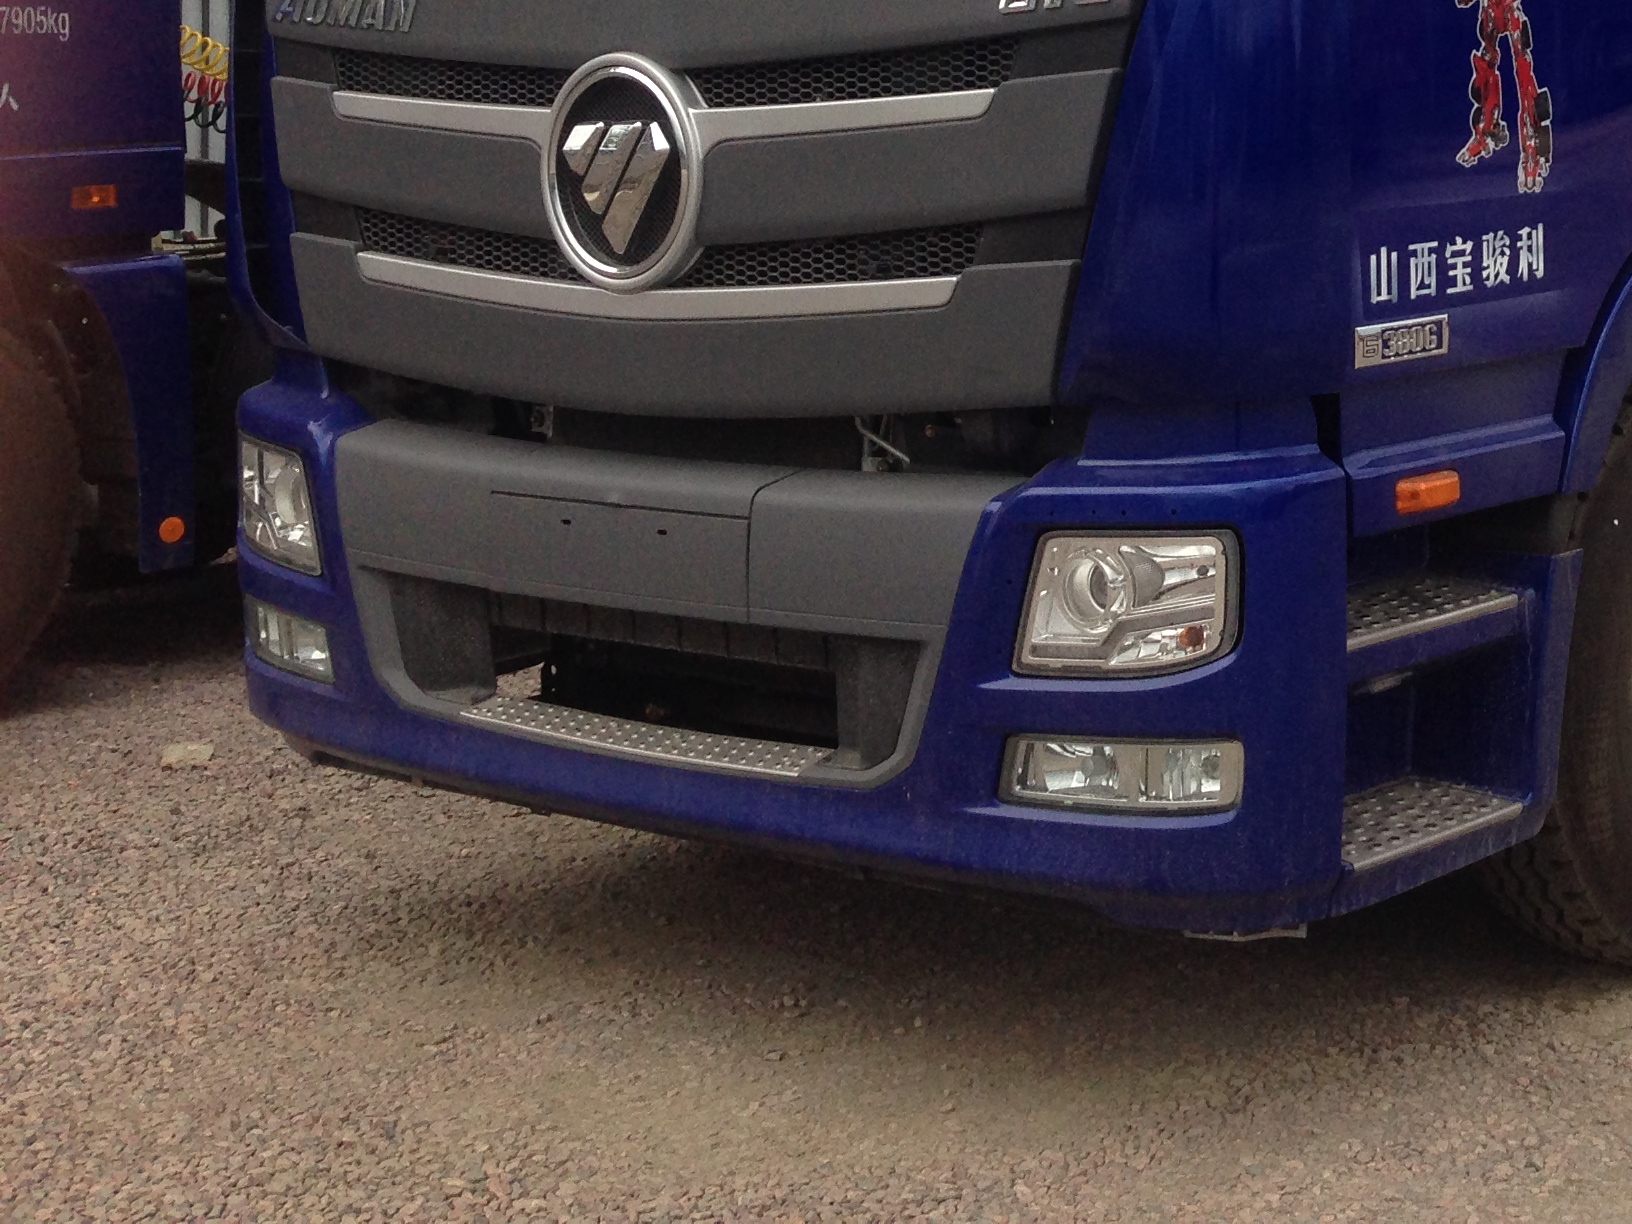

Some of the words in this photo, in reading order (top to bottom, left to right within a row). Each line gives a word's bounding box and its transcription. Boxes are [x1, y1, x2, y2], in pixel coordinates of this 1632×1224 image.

[1370, 222, 1545, 304] 山西宝骏利
